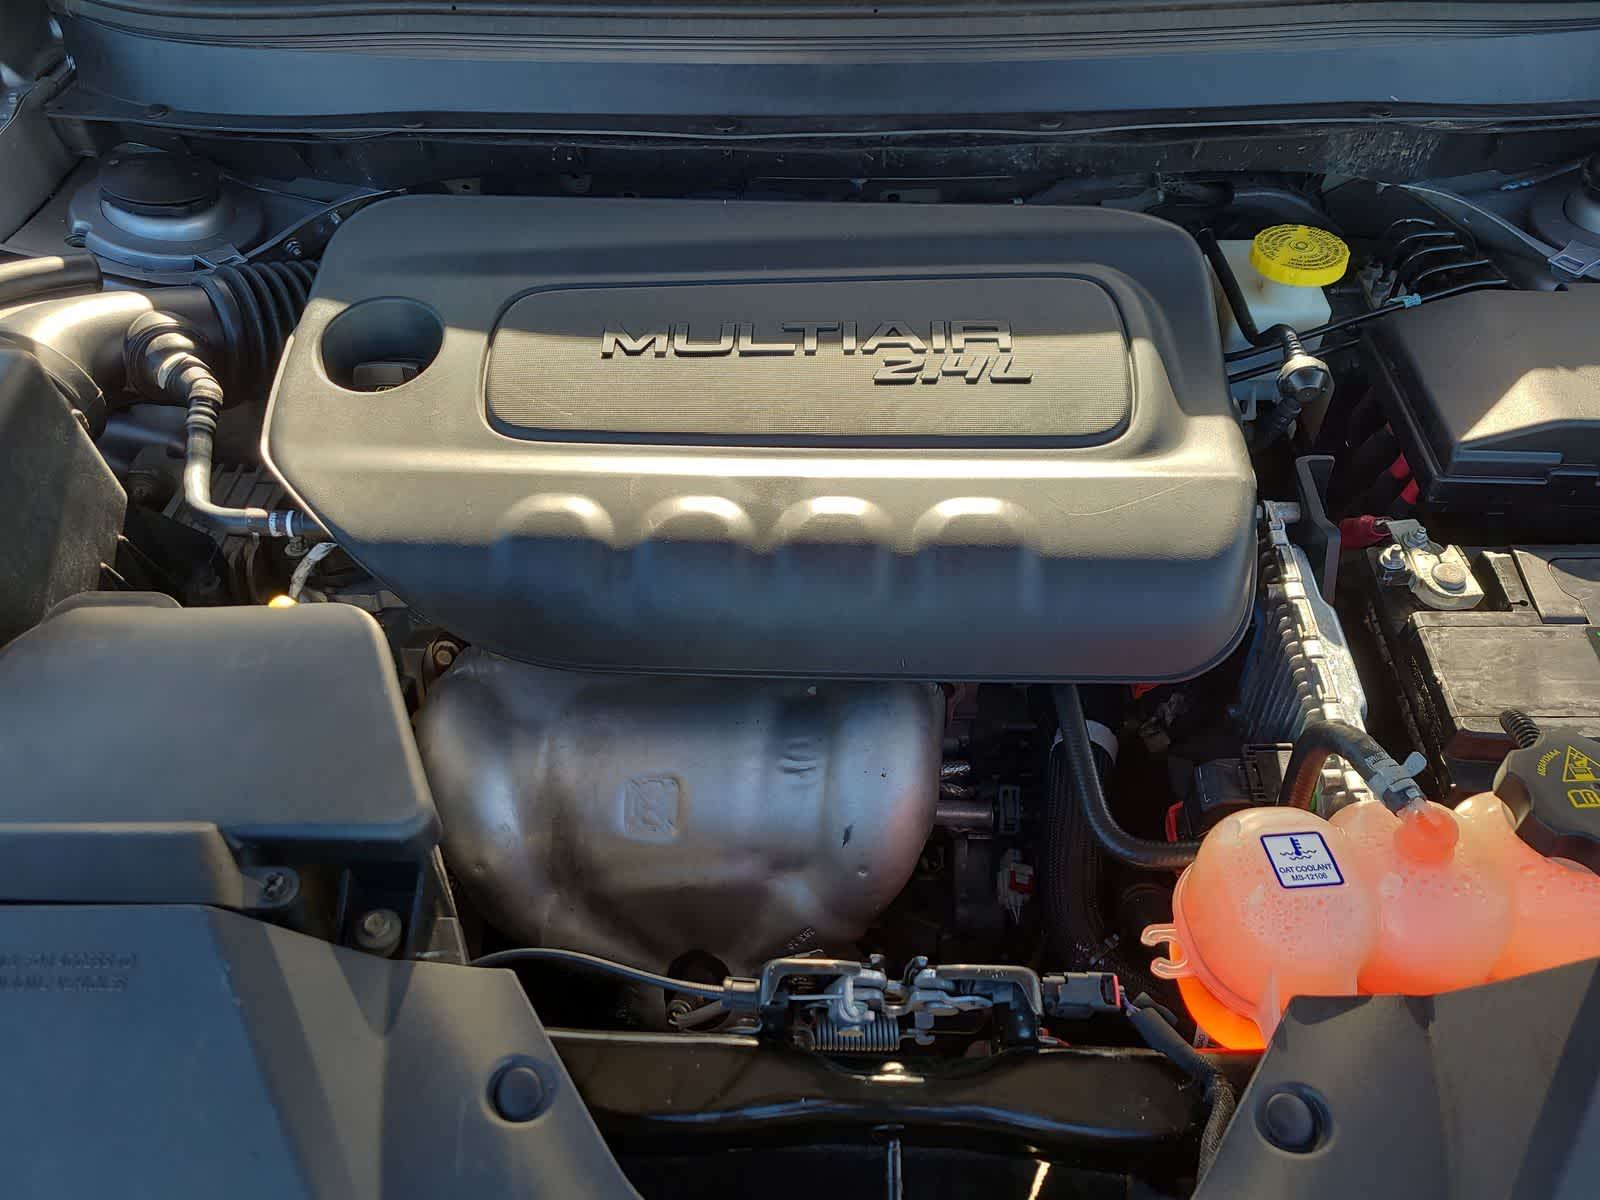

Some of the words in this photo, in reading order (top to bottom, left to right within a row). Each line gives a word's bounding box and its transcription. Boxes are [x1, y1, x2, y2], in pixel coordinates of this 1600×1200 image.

[601, 320, 1013, 357] MULTIAIR
[873, 356, 1033, 385] 2.4L
[1295, 863, 1332, 873] COOLANT
